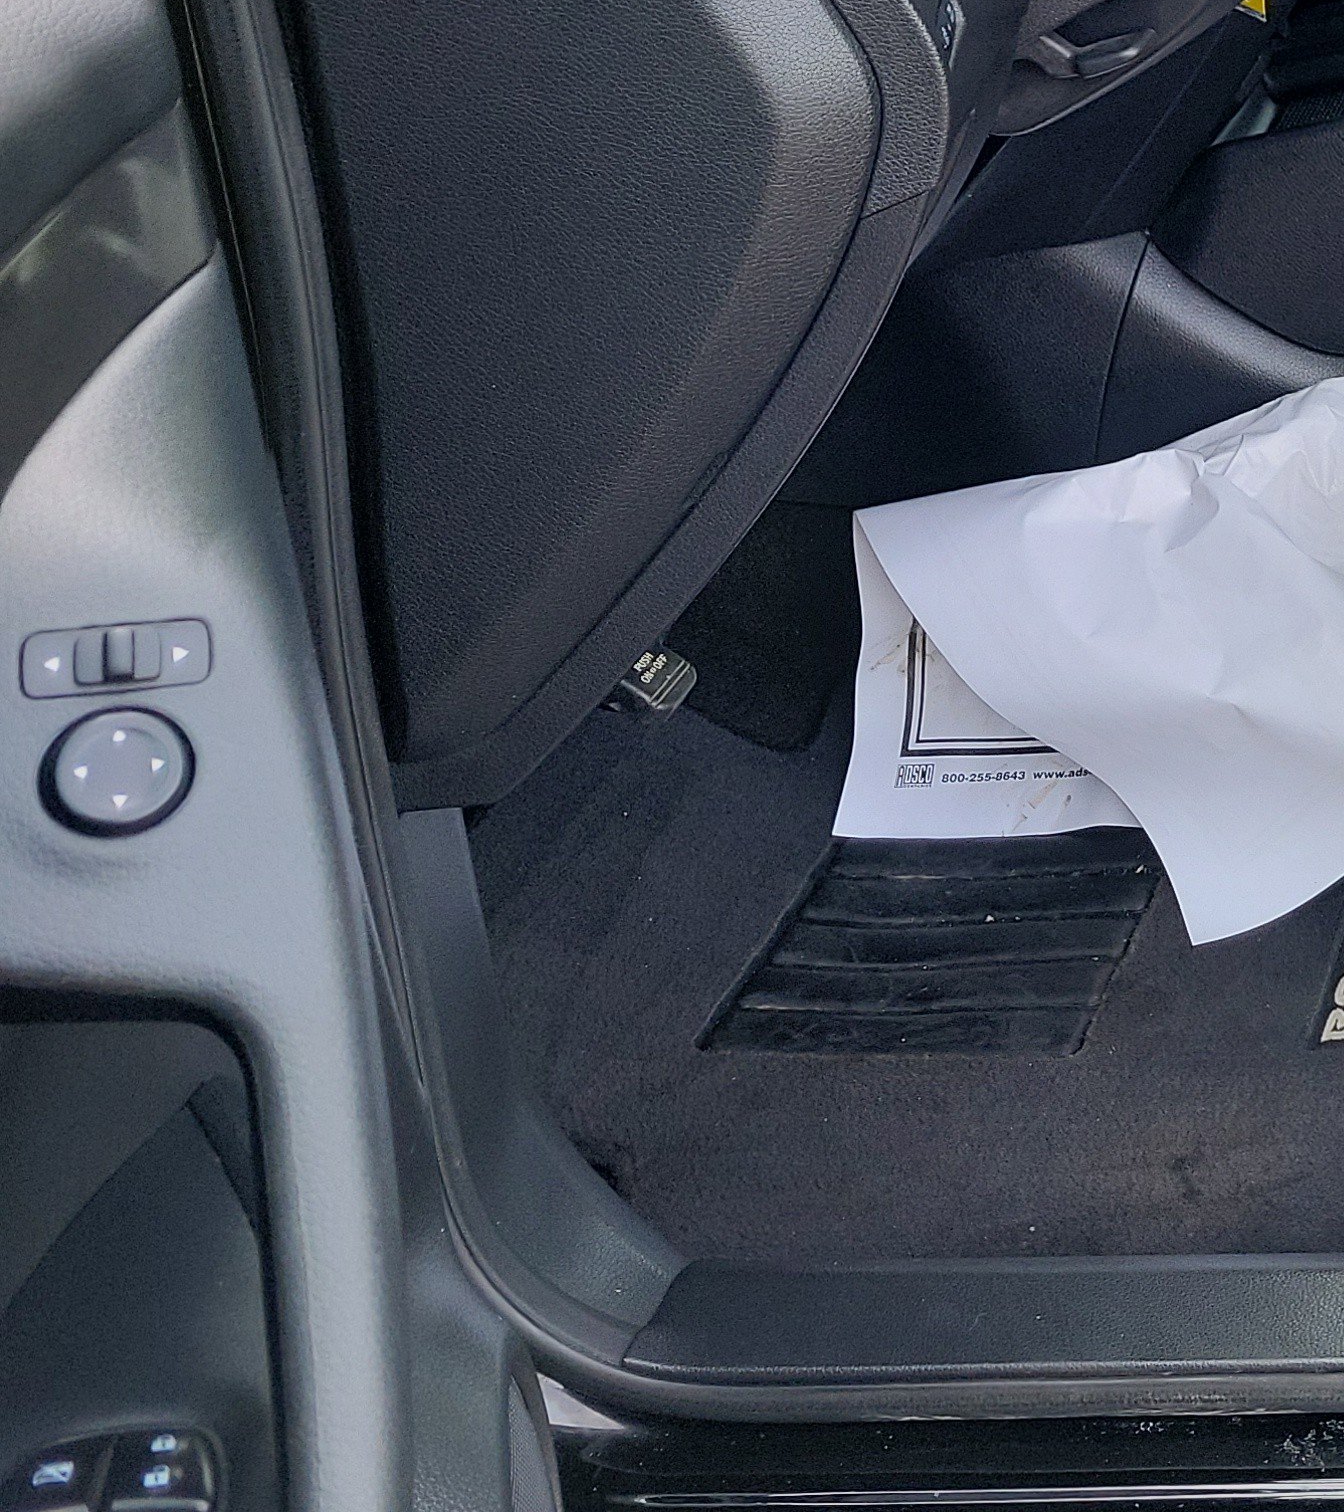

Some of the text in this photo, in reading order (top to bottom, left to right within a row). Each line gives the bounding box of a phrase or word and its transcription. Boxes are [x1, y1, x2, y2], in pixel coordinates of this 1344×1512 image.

[633, 652, 654, 672] PUSH
[640, 654, 667, 683] ON OFF
[894, 764, 1093, 788] ADSCO 800-255-8643 www.ads
